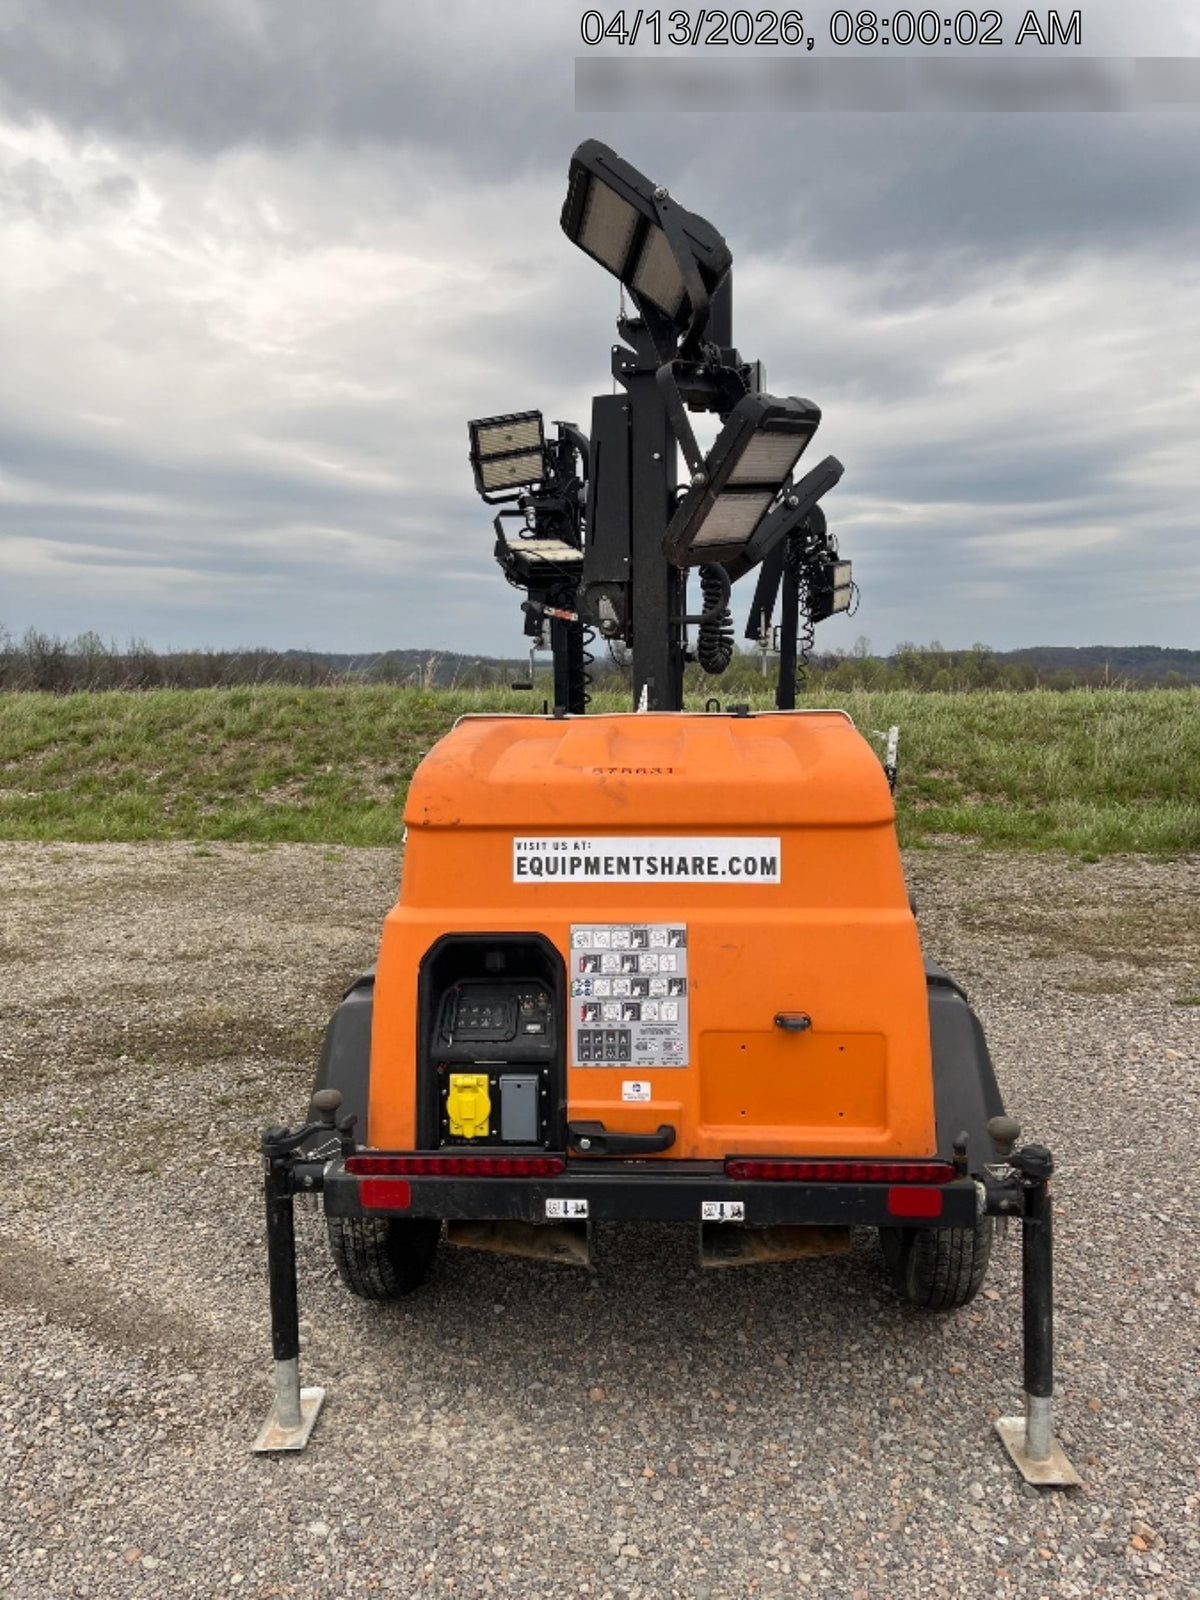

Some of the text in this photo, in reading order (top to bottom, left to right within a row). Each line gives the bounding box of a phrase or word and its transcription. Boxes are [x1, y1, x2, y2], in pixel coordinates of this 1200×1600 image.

[516, 841, 591, 851] VISIT US AT:
[516, 856, 777, 877] EQUIPMENTSHARE.COM
